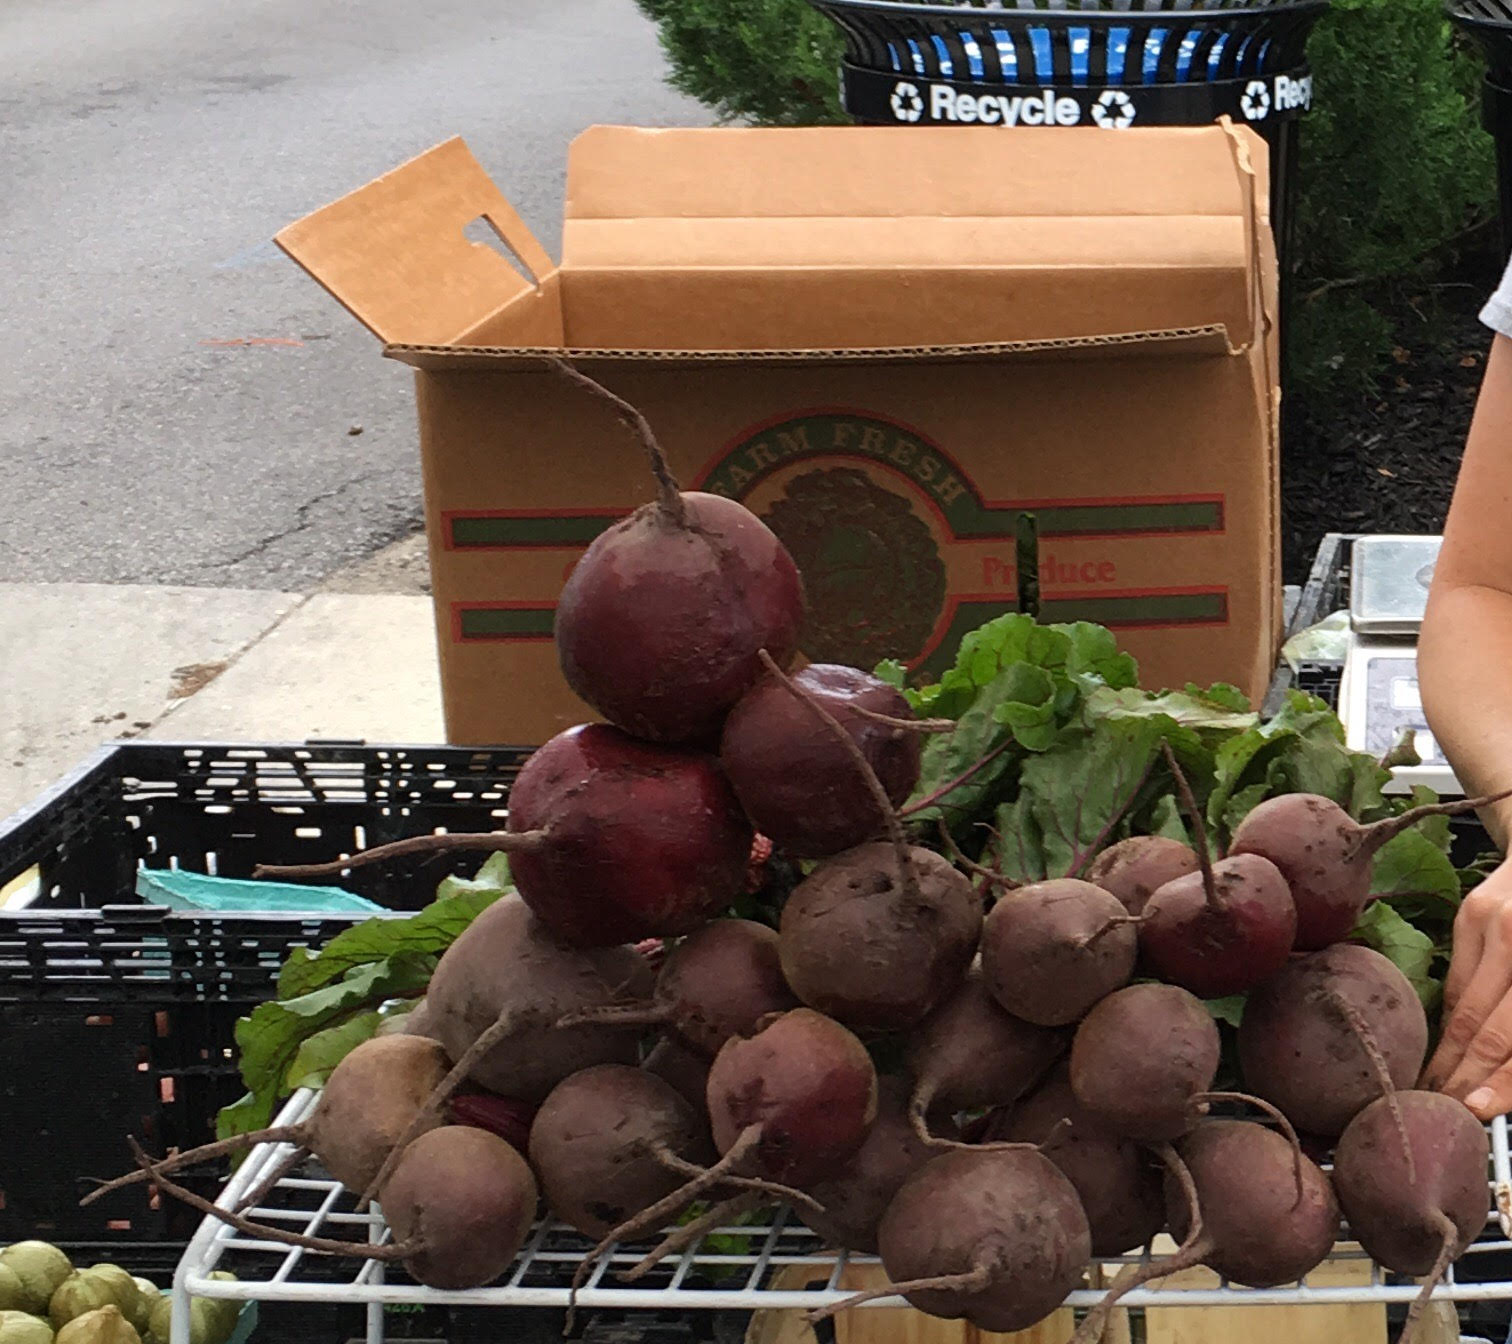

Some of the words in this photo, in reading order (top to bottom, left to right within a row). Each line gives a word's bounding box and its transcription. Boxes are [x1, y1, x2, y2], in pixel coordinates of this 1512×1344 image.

[929, 84, 1081, 127] Recycle
[831, 421, 968, 506] FRESH
[980, 553, 1118, 586] Prduce
